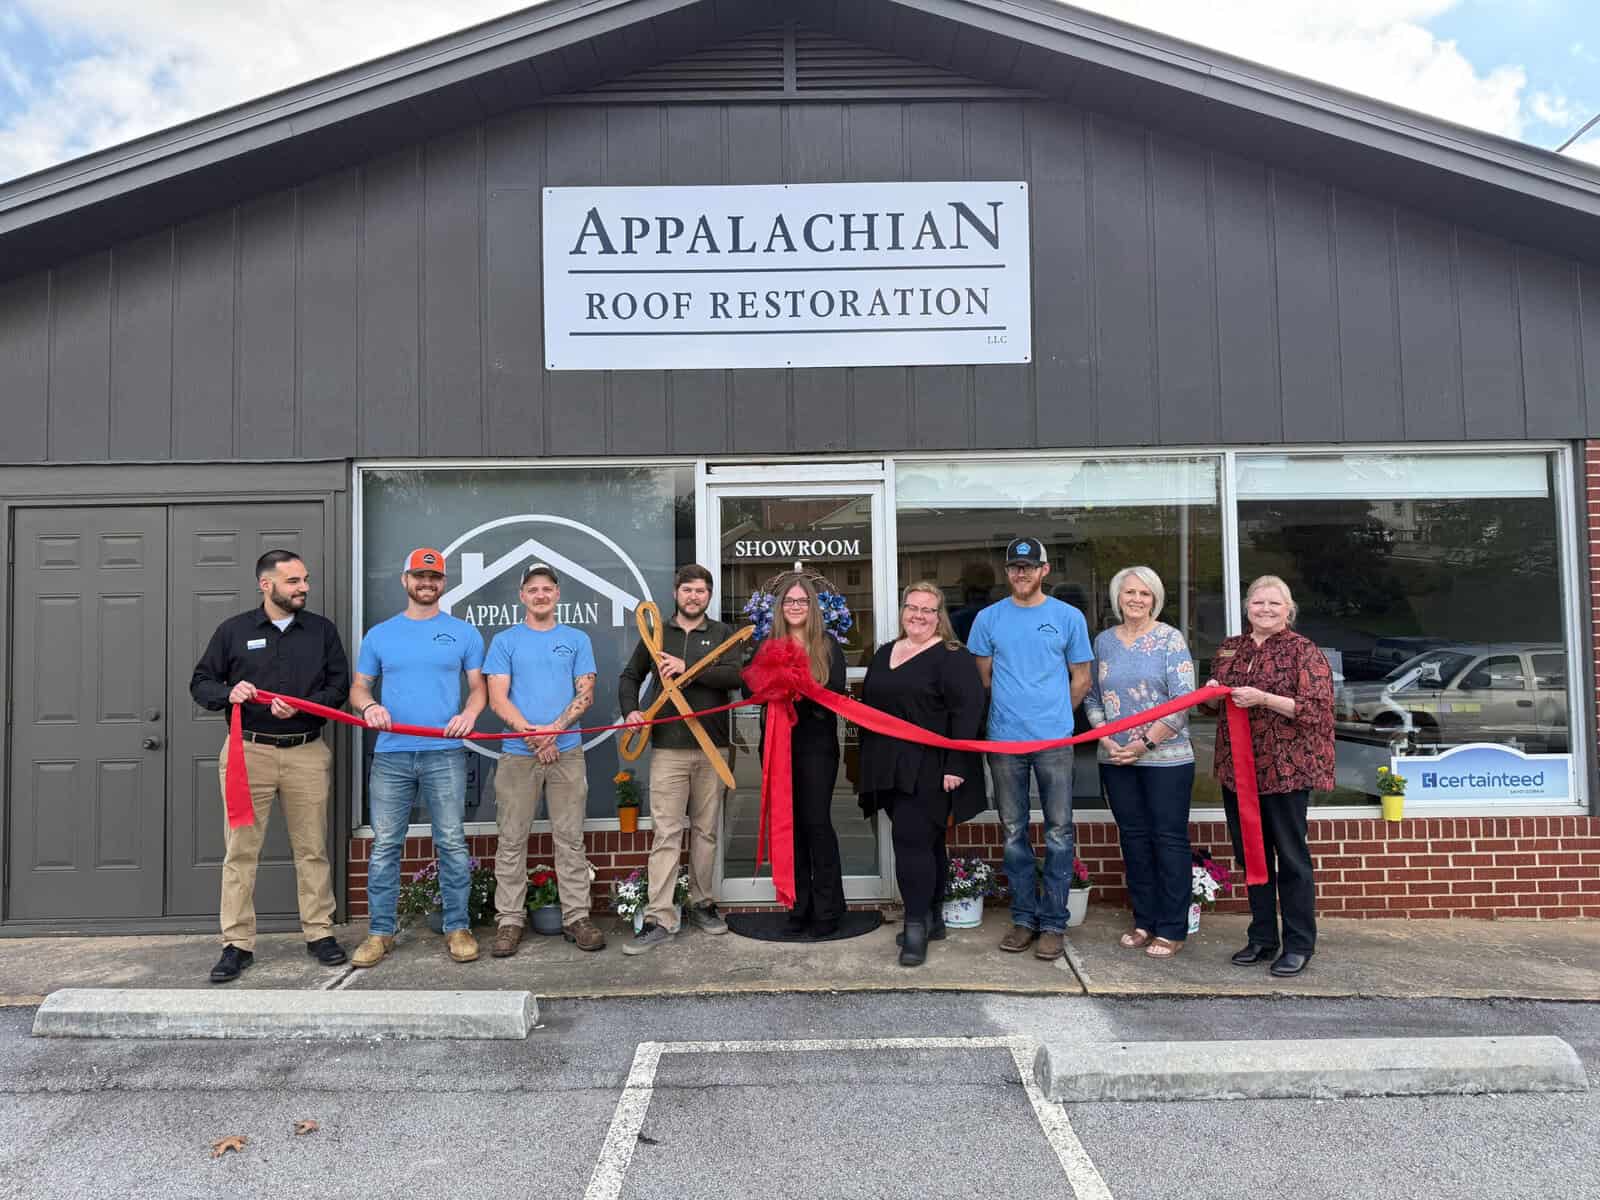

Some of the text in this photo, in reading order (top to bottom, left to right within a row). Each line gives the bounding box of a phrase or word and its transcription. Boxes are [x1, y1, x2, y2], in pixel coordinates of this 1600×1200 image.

[569, 202, 1003, 255] APPALACHIAN
[585, 288, 989, 320] ROOF RESTORATION
[985, 336, 1007, 344] LLC
[736, 540, 859, 556] SHOWROOM
[464, 602, 599, 626] APPALHIAN
[1439, 771, 1544, 787] certainteed
